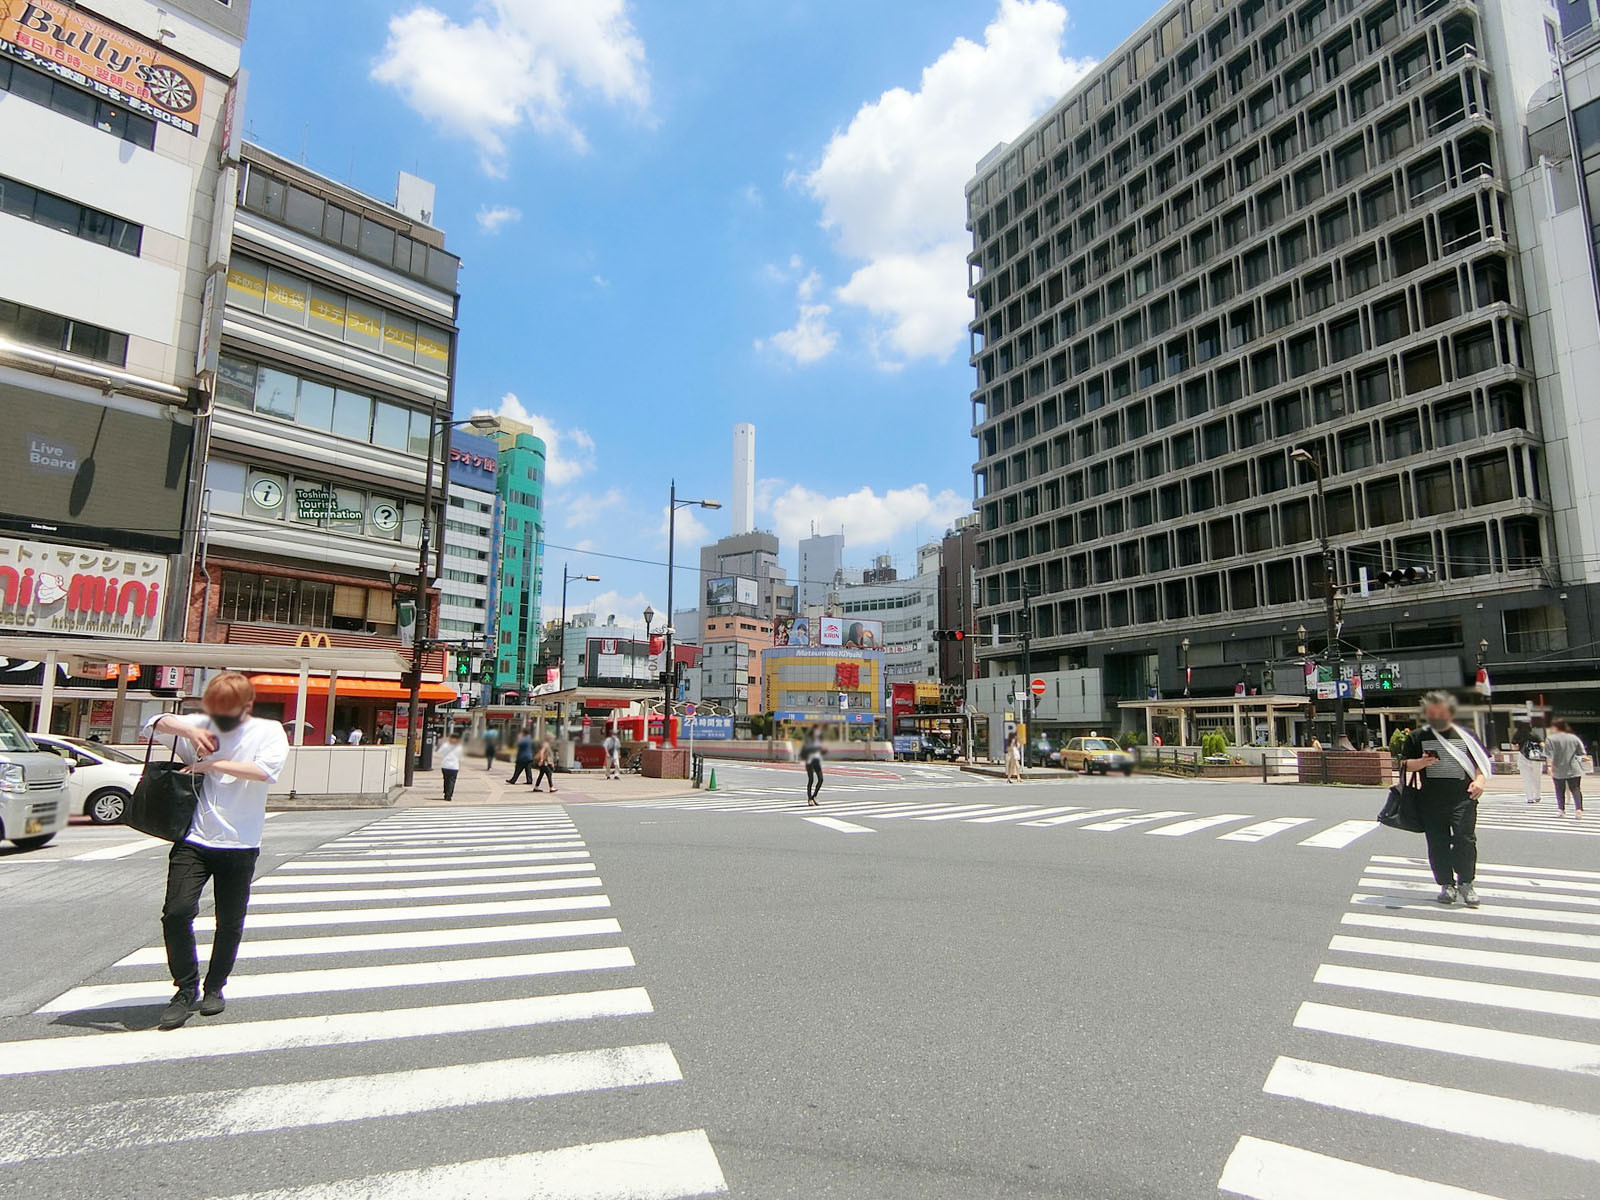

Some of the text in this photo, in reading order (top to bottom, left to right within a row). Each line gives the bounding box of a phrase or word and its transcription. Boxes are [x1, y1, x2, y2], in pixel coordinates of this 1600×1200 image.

[14, 2, 155, 81] Bully's
[31, 441, 63, 456] Live
[30, 453, 76, 470] Board
[297, 490, 337, 500] Toshima
[299, 500, 337, 509] Tourist
[299, 509, 362, 520] Information
[67, 573, 159, 618] mini
[836, 662, 859, 688] 薬
[1338, 683, 1348, 697] P
